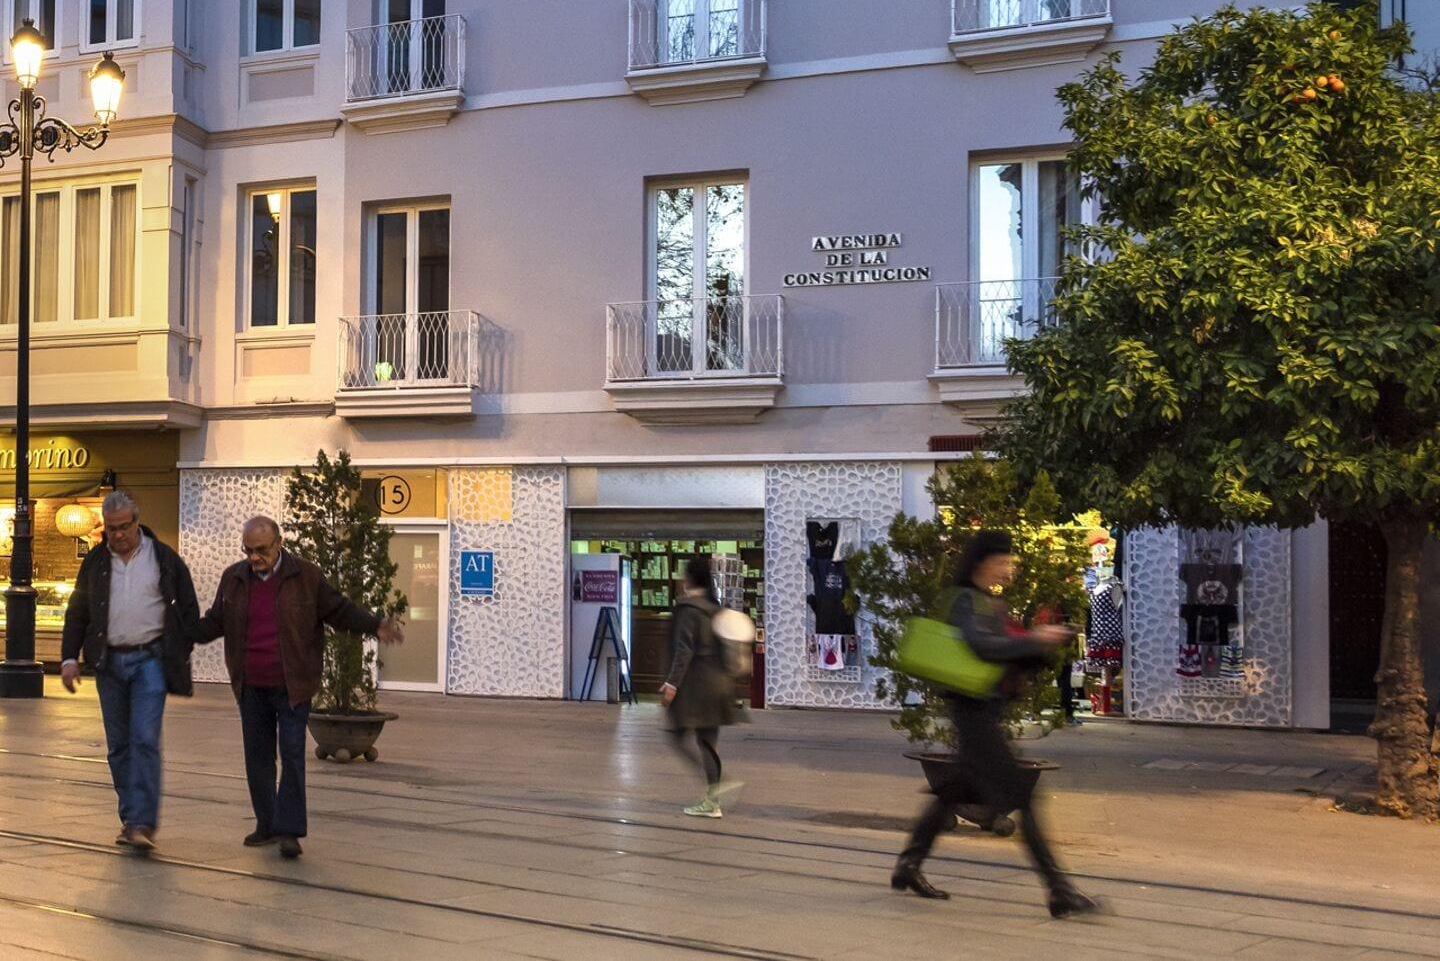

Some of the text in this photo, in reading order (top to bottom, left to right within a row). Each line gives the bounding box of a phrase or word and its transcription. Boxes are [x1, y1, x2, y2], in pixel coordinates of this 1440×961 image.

[813, 233, 900, 250] AVENIDA
[826, 252, 885, 266] DE LA
[783, 267, 931, 286] CONSTITUCION
[380, 484, 405, 505] 15
[465, 554, 490, 572] AT
